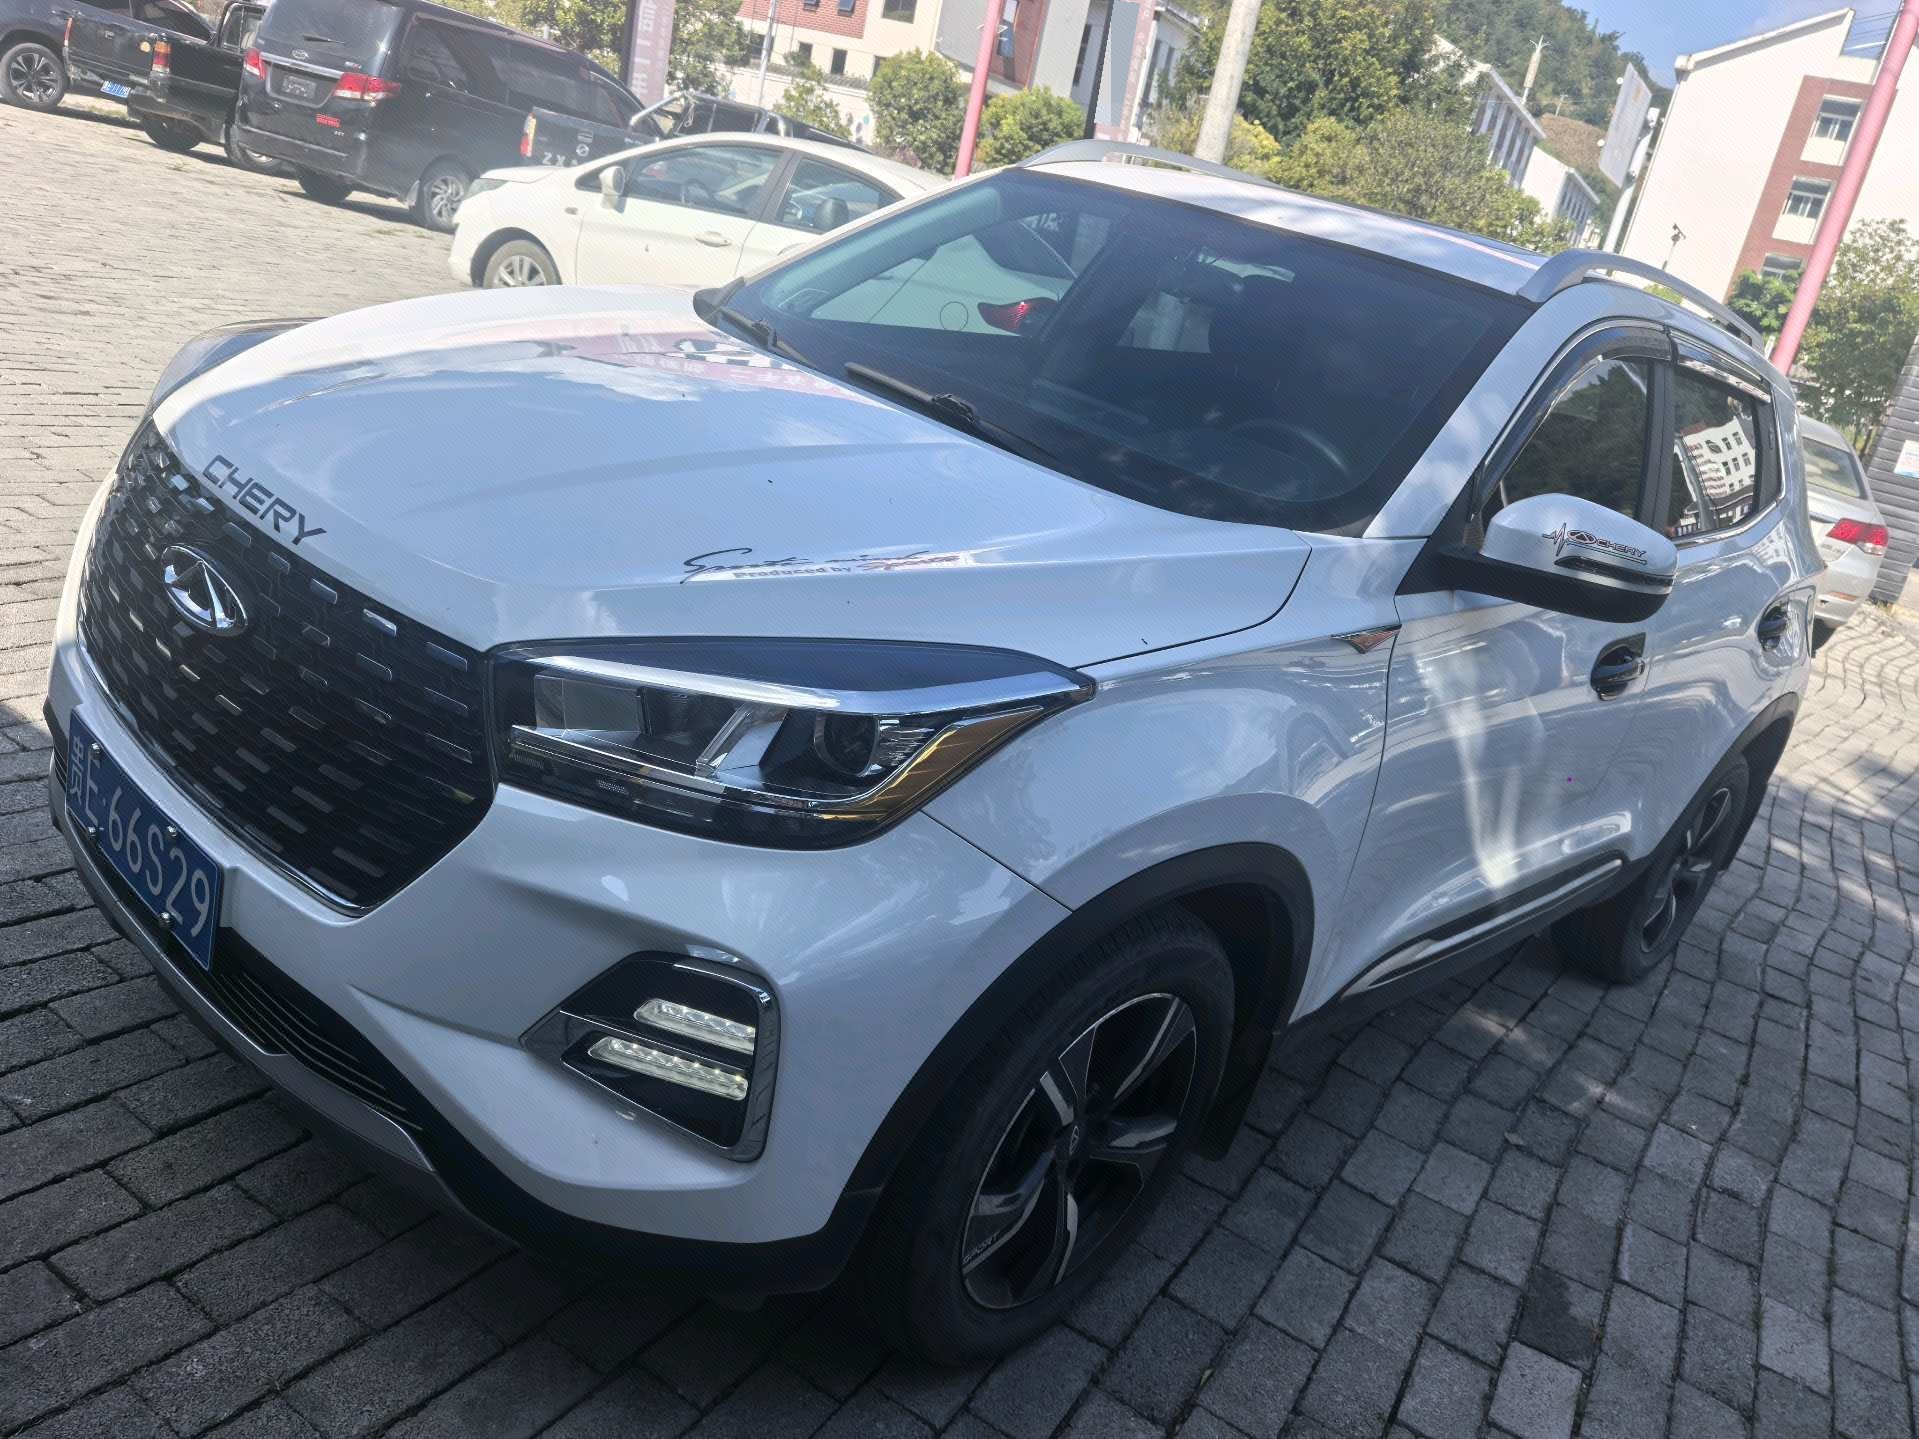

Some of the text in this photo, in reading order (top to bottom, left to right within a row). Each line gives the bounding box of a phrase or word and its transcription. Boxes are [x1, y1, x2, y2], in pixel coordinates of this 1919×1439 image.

[202, 454, 327, 546] CHERY
[1597, 538, 1647, 558] CHERY
[732, 567, 826, 579] Produced
[829, 566, 852, 574] by
